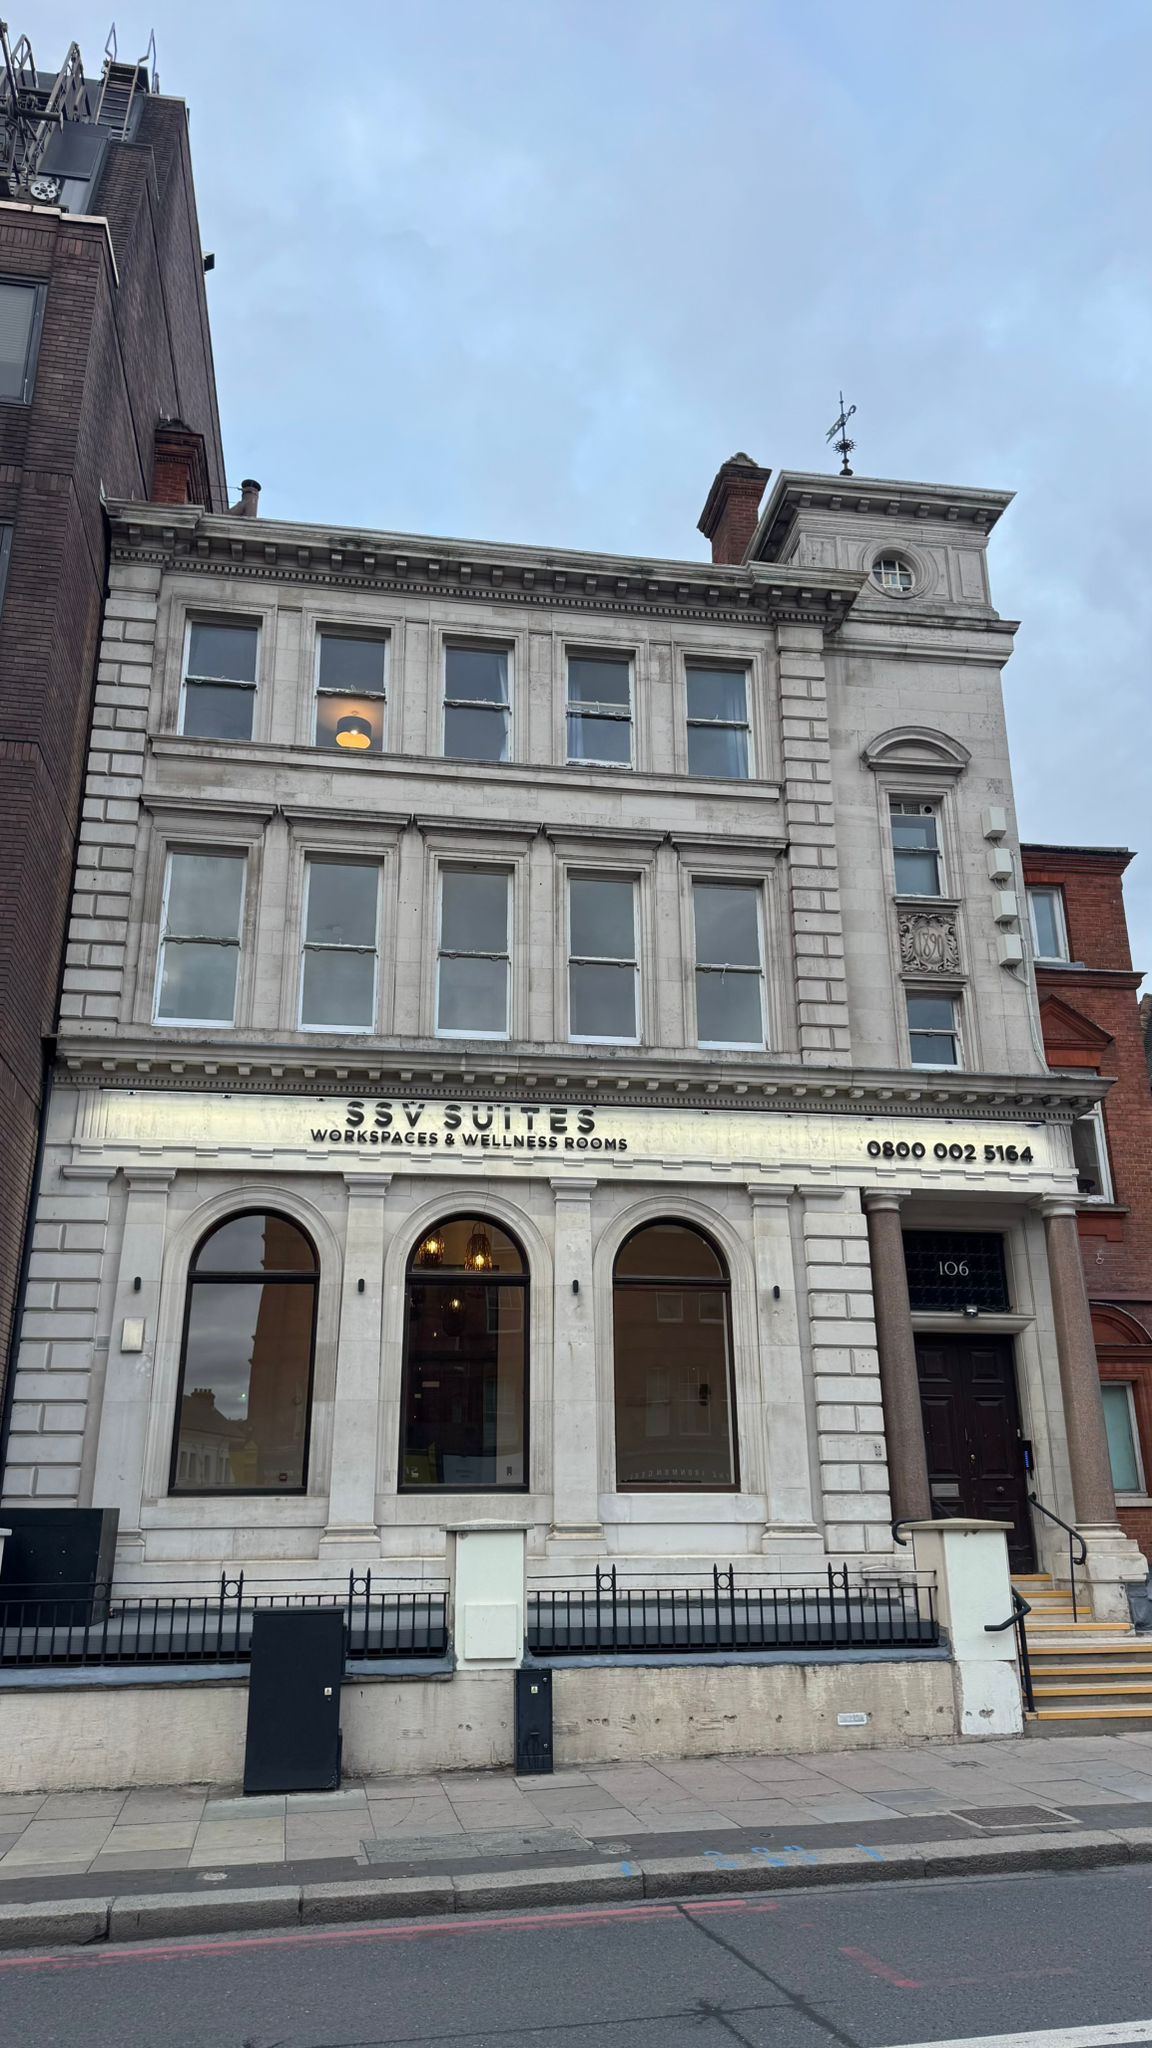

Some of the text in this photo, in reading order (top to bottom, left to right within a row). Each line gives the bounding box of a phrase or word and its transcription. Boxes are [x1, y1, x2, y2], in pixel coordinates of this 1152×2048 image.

[346, 1101, 595, 1133] SSV SUITES
[311, 1129, 627, 1150] WORKSPACES & WELLNESS ROOMS
[867, 1140, 1033, 1162] 0800 002 5164
[939, 1260, 969, 1276] 106
